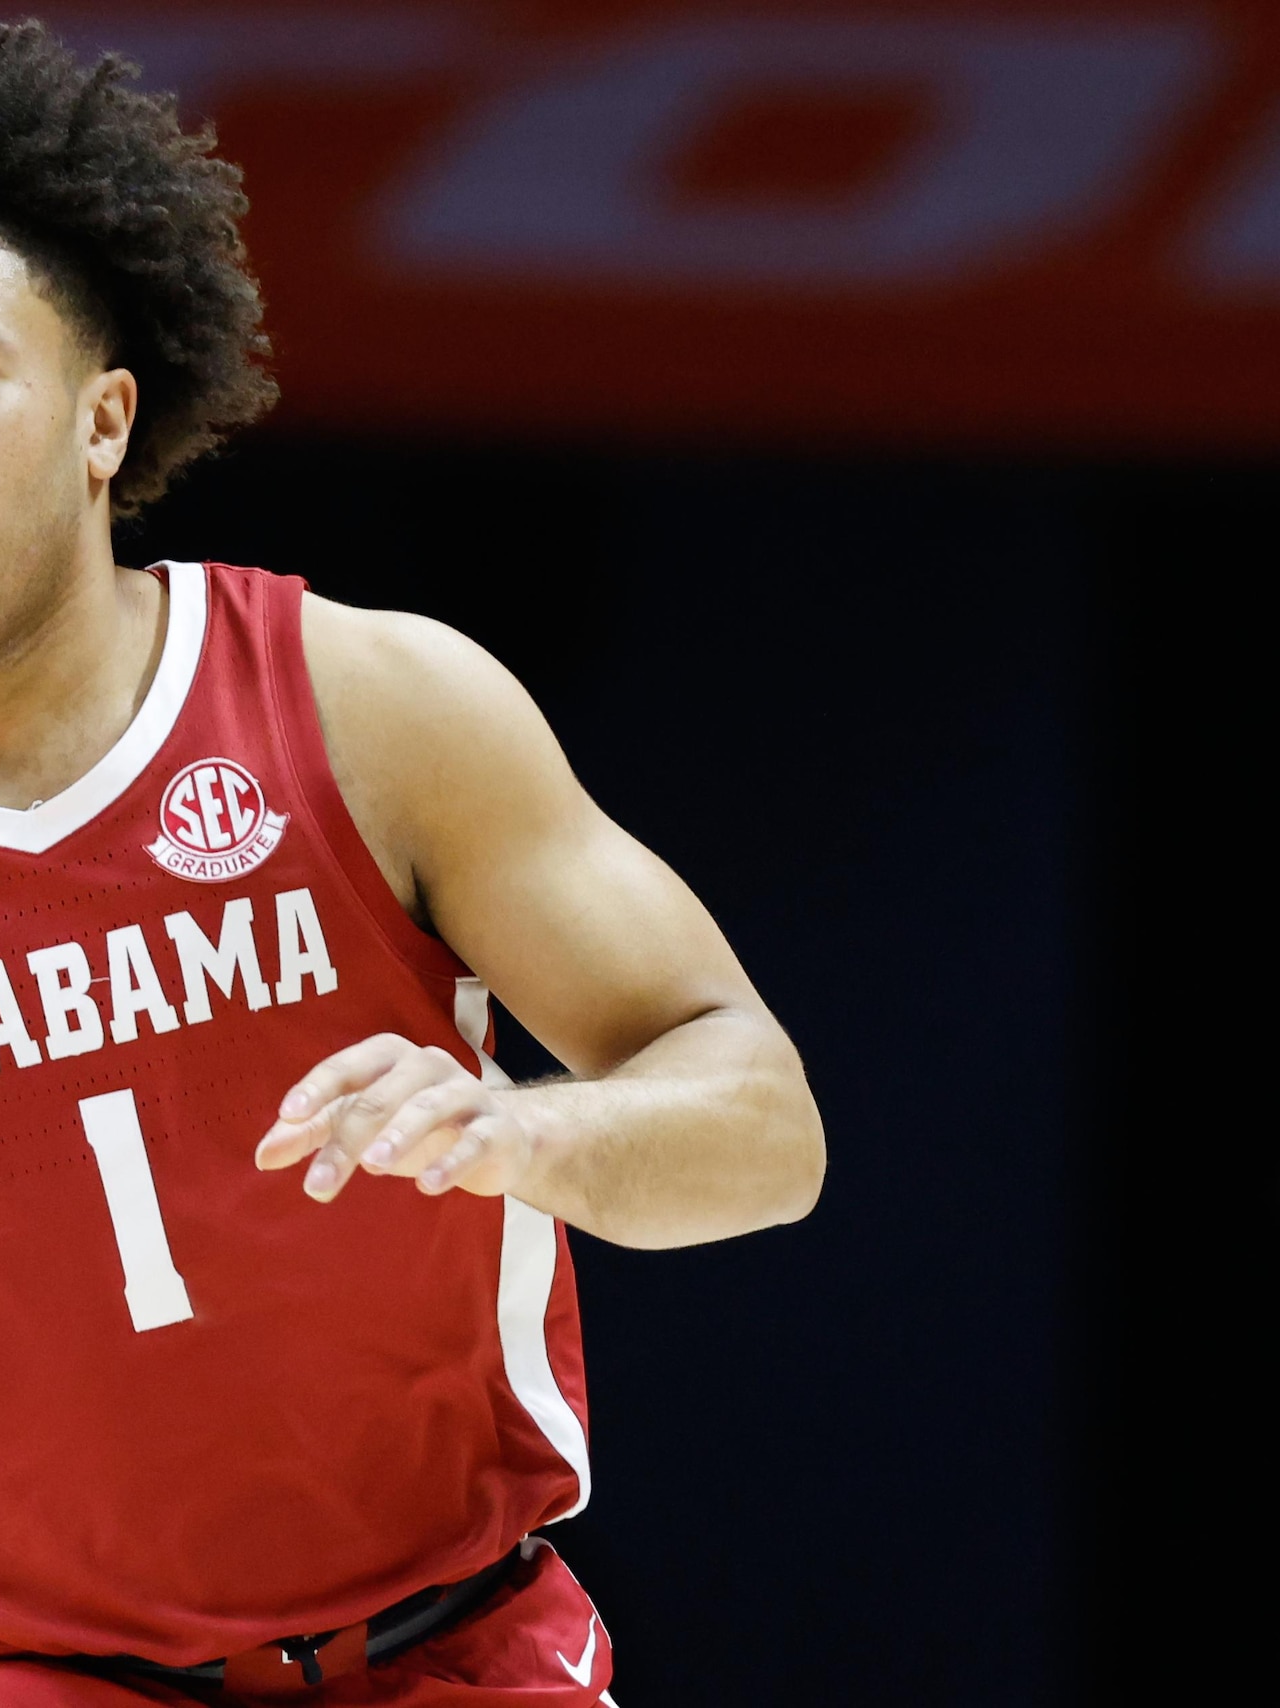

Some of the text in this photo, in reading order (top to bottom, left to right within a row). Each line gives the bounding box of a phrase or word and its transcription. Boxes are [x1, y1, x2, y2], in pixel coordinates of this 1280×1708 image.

[168, 766, 256, 851] SEC
[166, 832, 275, 878] GRADUATE
[78, 1088, 196, 1333] 1
